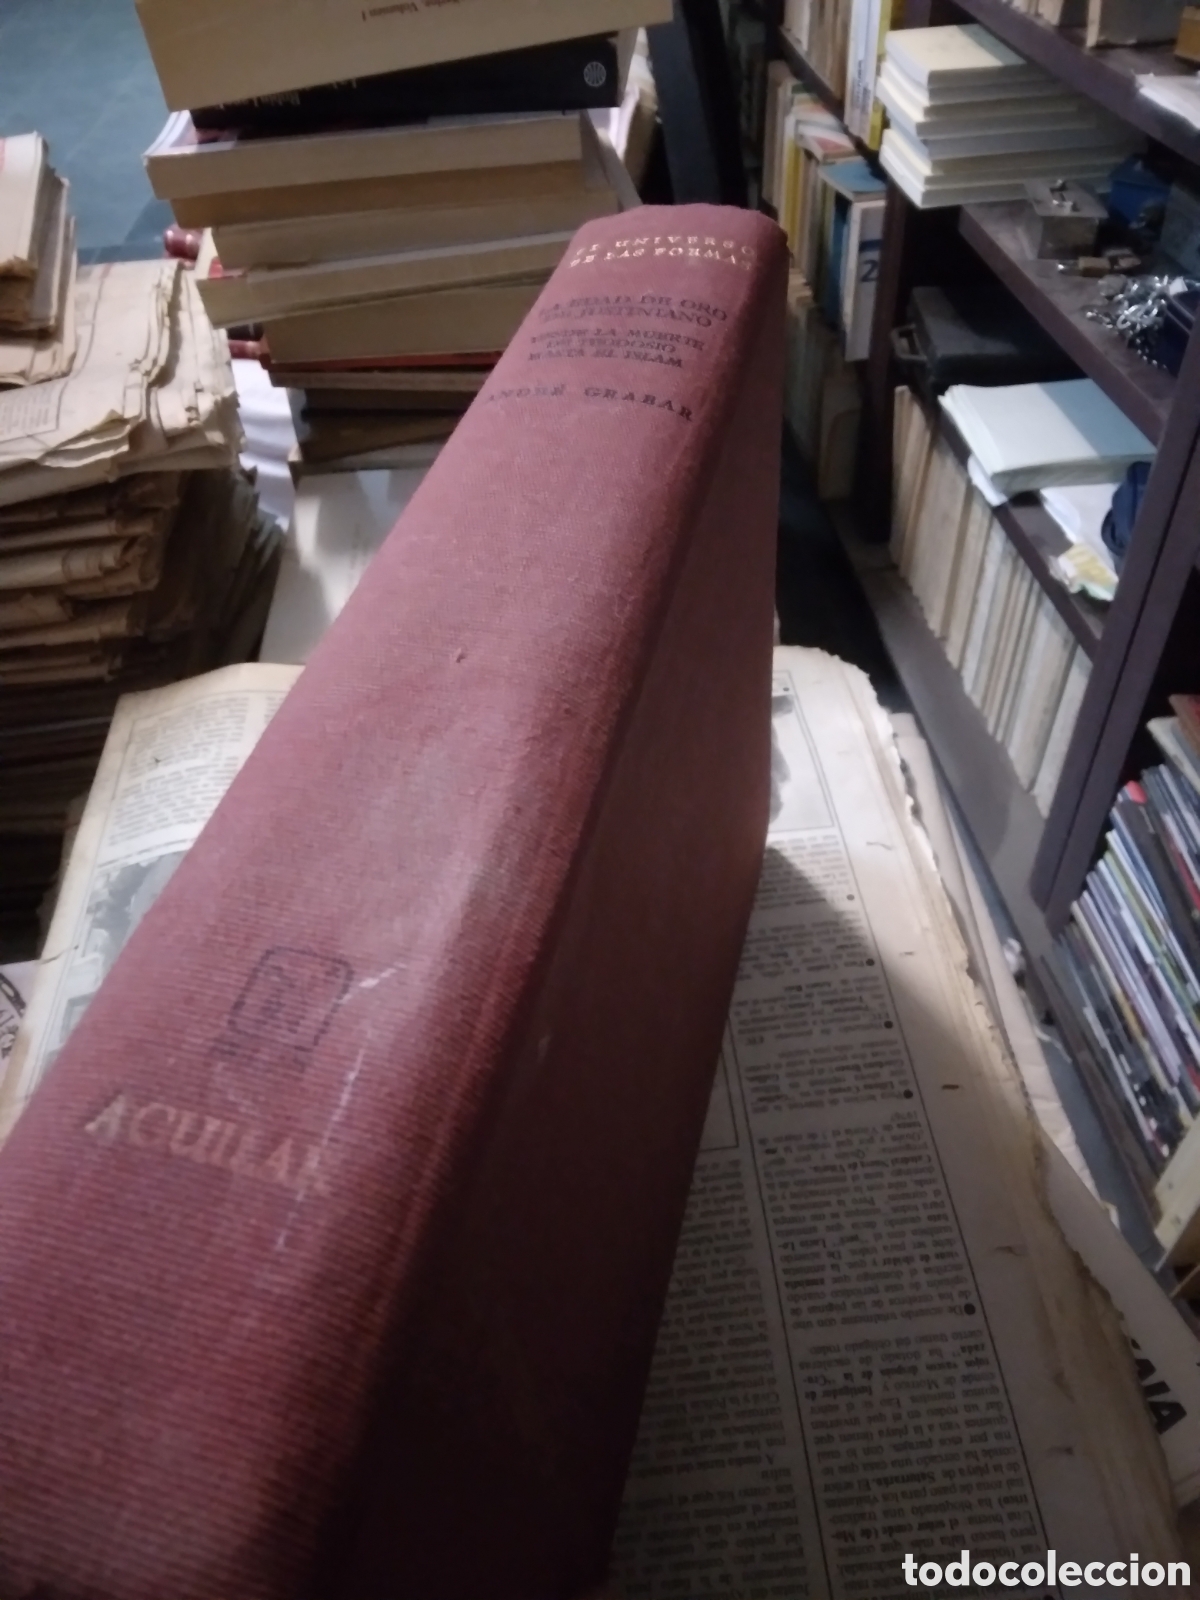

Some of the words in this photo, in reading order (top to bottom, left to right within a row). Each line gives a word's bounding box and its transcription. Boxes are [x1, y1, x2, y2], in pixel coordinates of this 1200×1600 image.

[615, 235, 756, 256] UNIVERSO
[654, 247, 752, 271] FORMAS
[680, 299, 728, 322] ORO
[627, 329, 705, 351] MUERTE
[623, 350, 683, 368] ISLAM
[584, 386, 693, 422] GRABAR
[85, 1093, 327, 1198] AGUILAR
